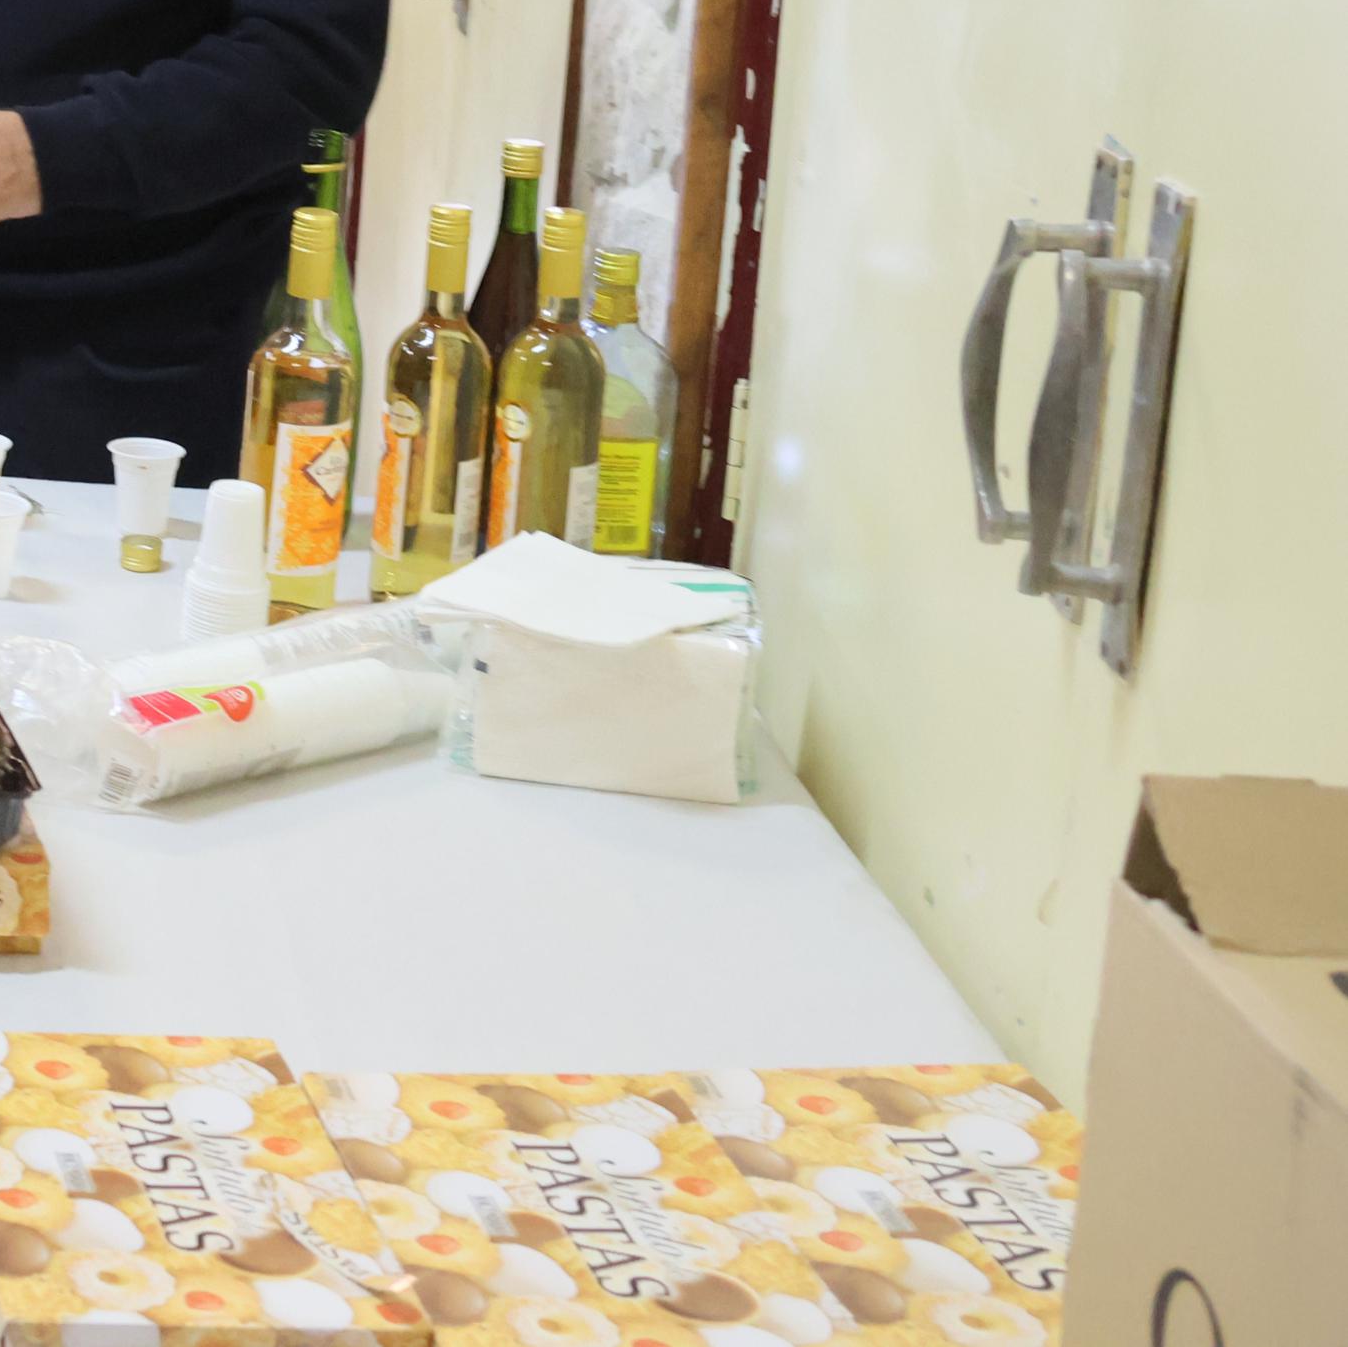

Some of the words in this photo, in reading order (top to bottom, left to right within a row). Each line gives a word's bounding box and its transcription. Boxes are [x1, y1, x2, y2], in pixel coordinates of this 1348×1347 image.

[110, 1101, 235, 1253] PASTAS
[512, 1140, 670, 1298] PASTAS
[885, 1133, 1068, 1291] PASTAS
